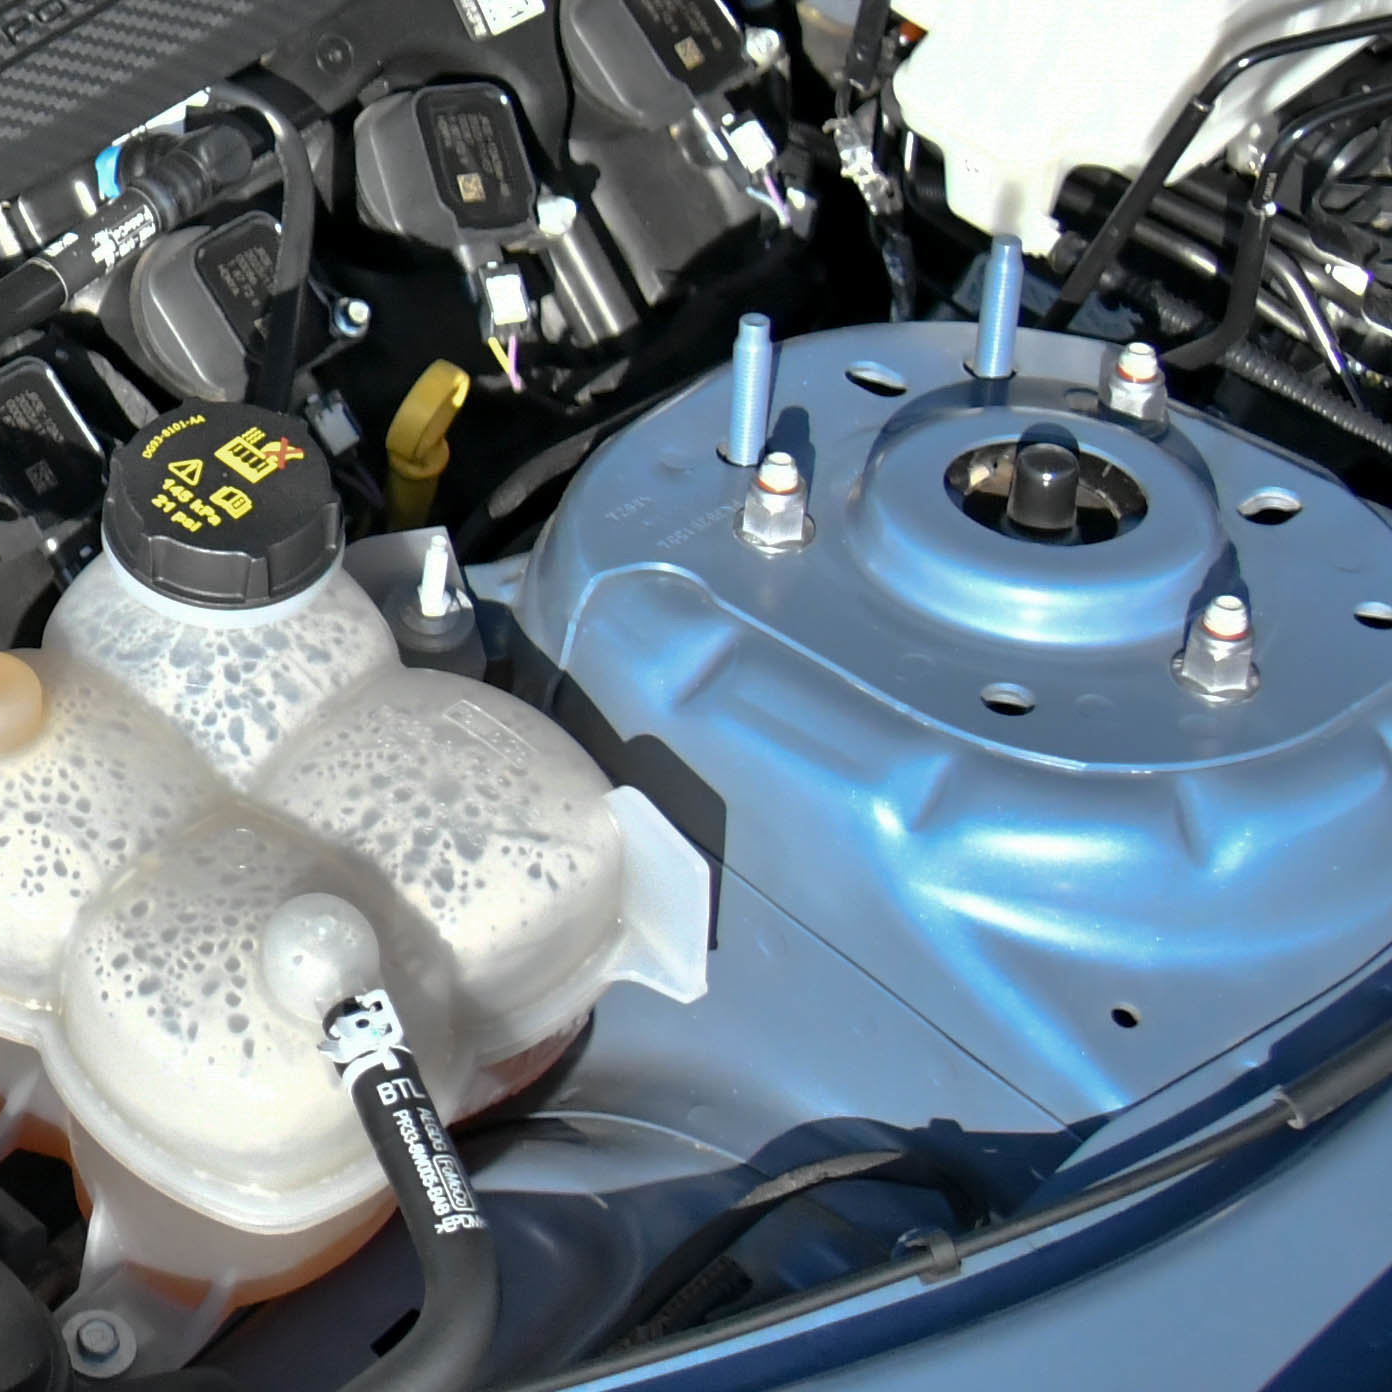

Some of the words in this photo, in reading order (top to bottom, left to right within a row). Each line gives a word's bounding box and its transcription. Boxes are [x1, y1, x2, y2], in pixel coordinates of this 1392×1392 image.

[151, 494, 177, 513] 21
[170, 511, 203, 533] psi
[162, 478, 194, 503] 145
[189, 499, 222, 526] kPa
[376, 1077, 425, 1106] BTL
[437, 1158, 468, 1208] FoMoCo
